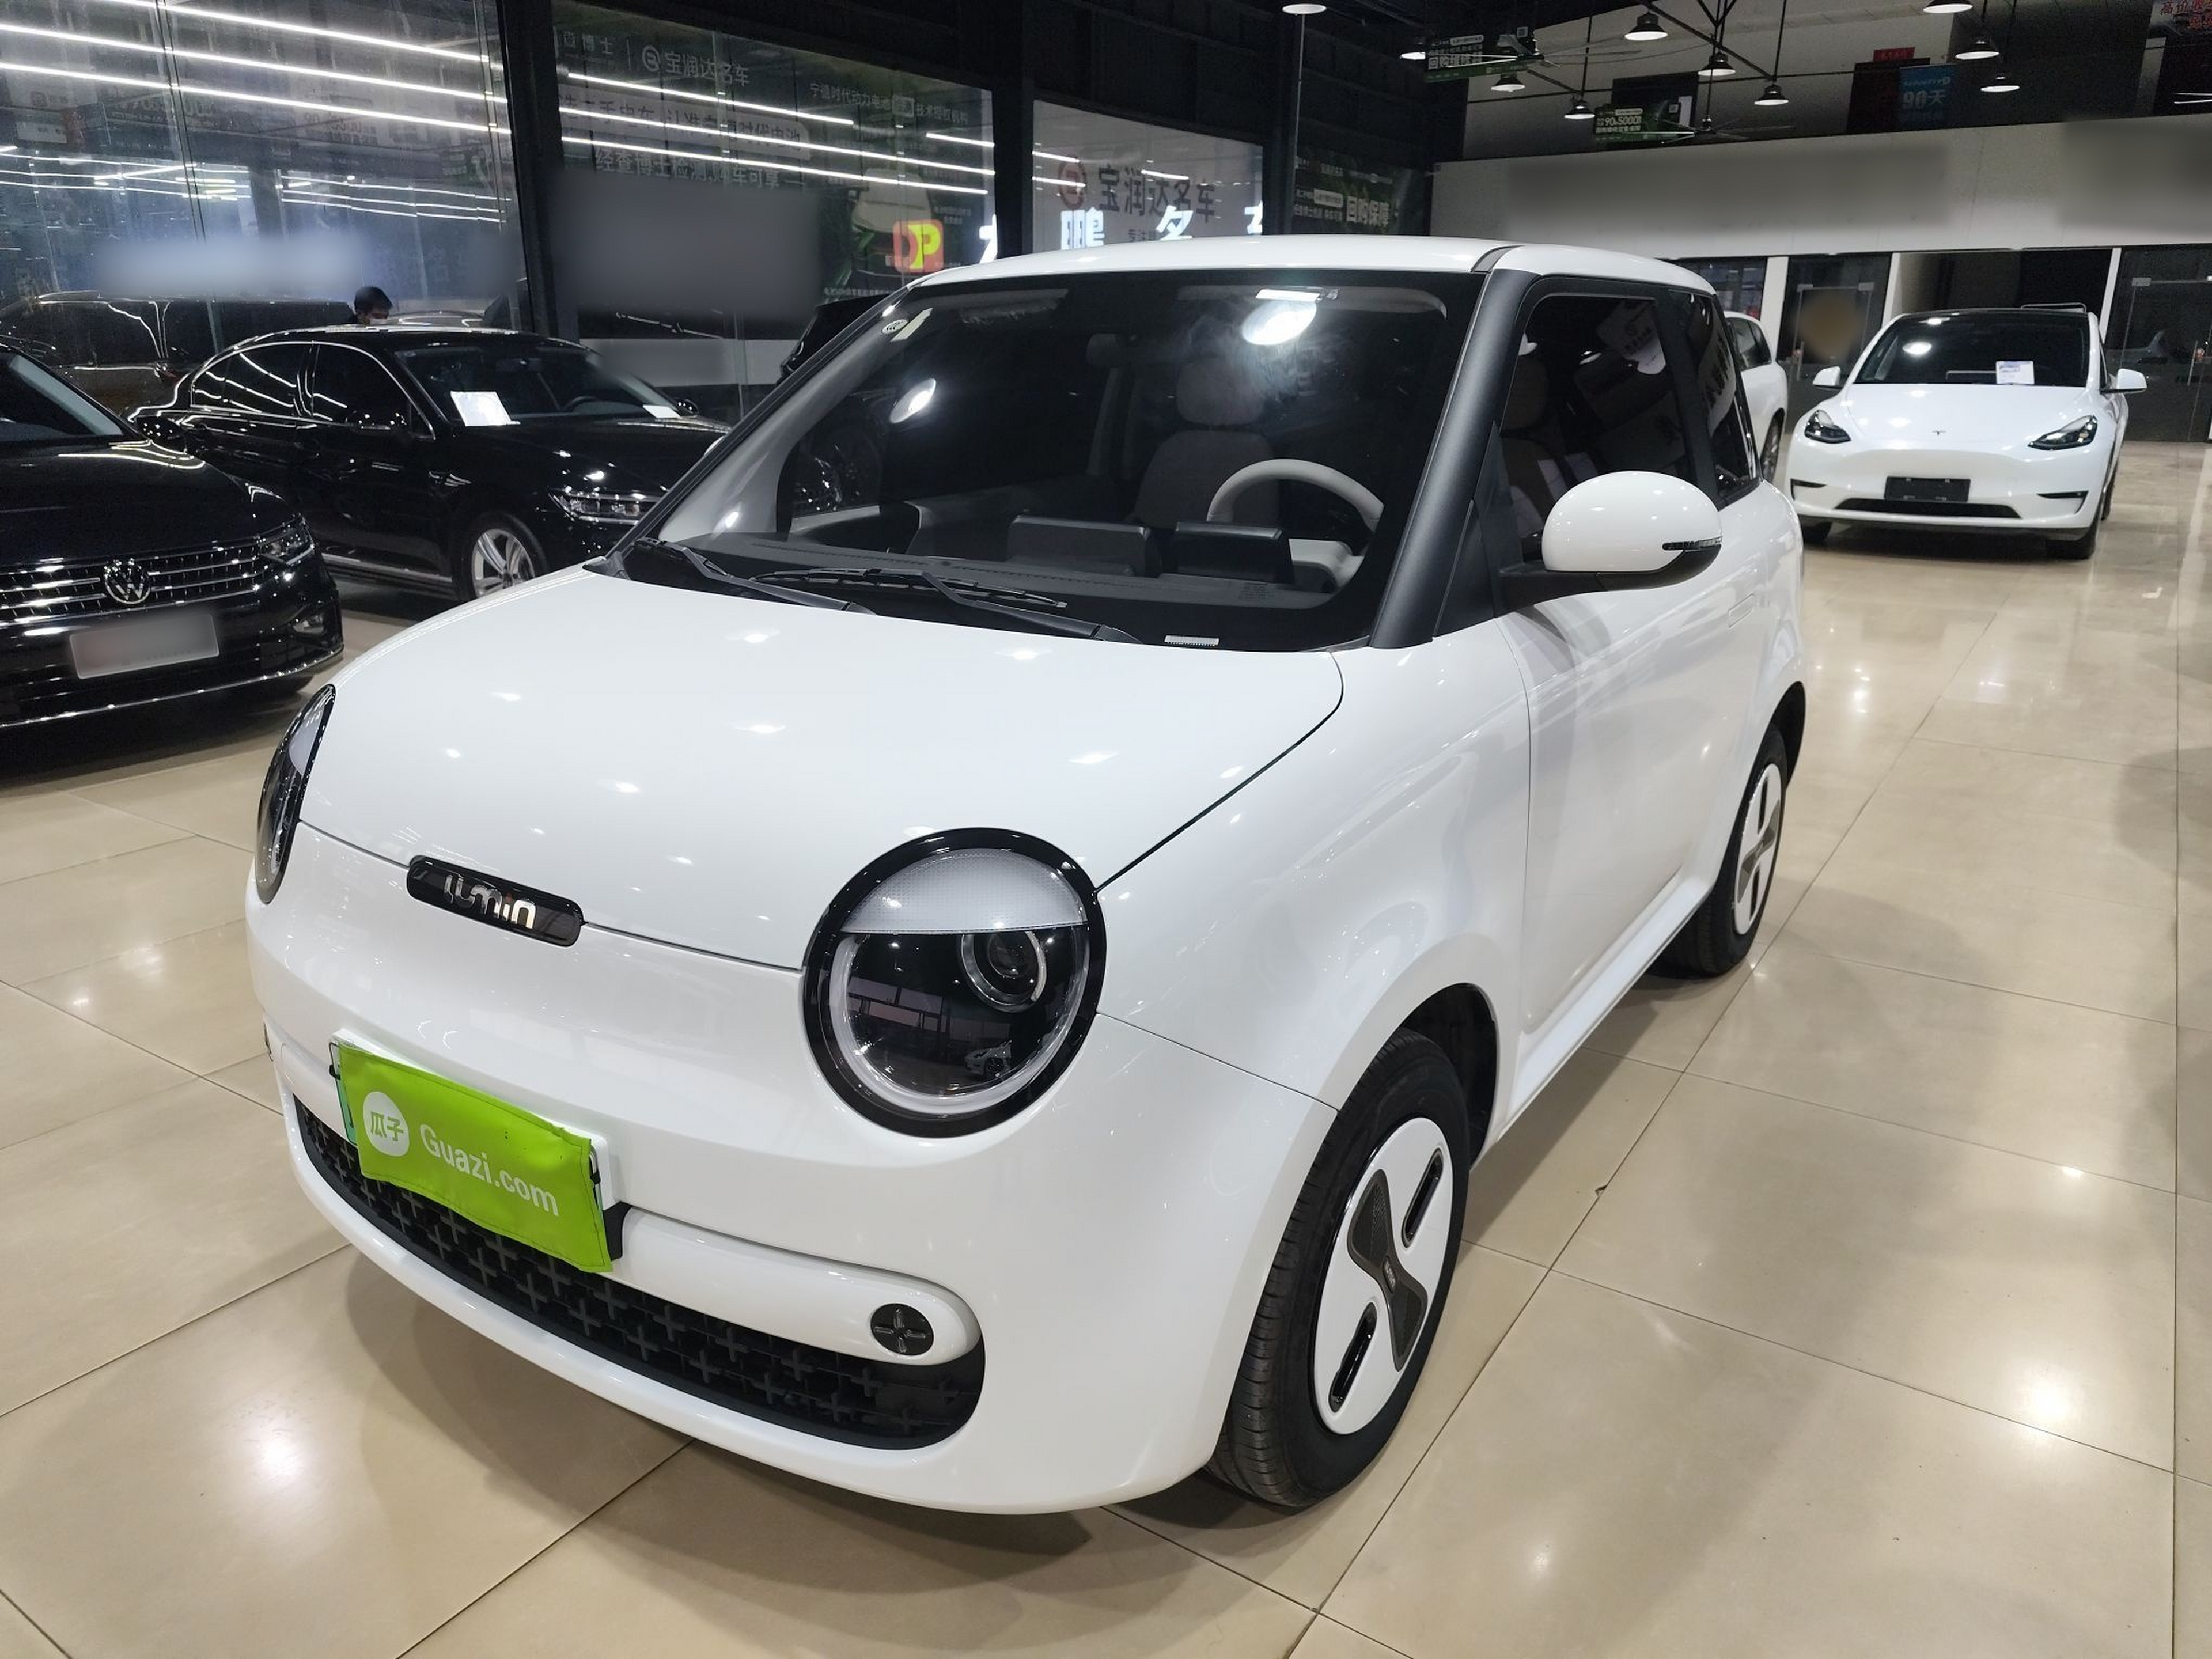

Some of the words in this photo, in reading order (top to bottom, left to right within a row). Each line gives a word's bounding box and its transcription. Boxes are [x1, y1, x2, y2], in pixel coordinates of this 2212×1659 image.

[1098, 163, 1215, 223] 宝润达名车
[370, 1111, 404, 1142] 瓜子
[419, 1123, 559, 1217] Guazi.com
